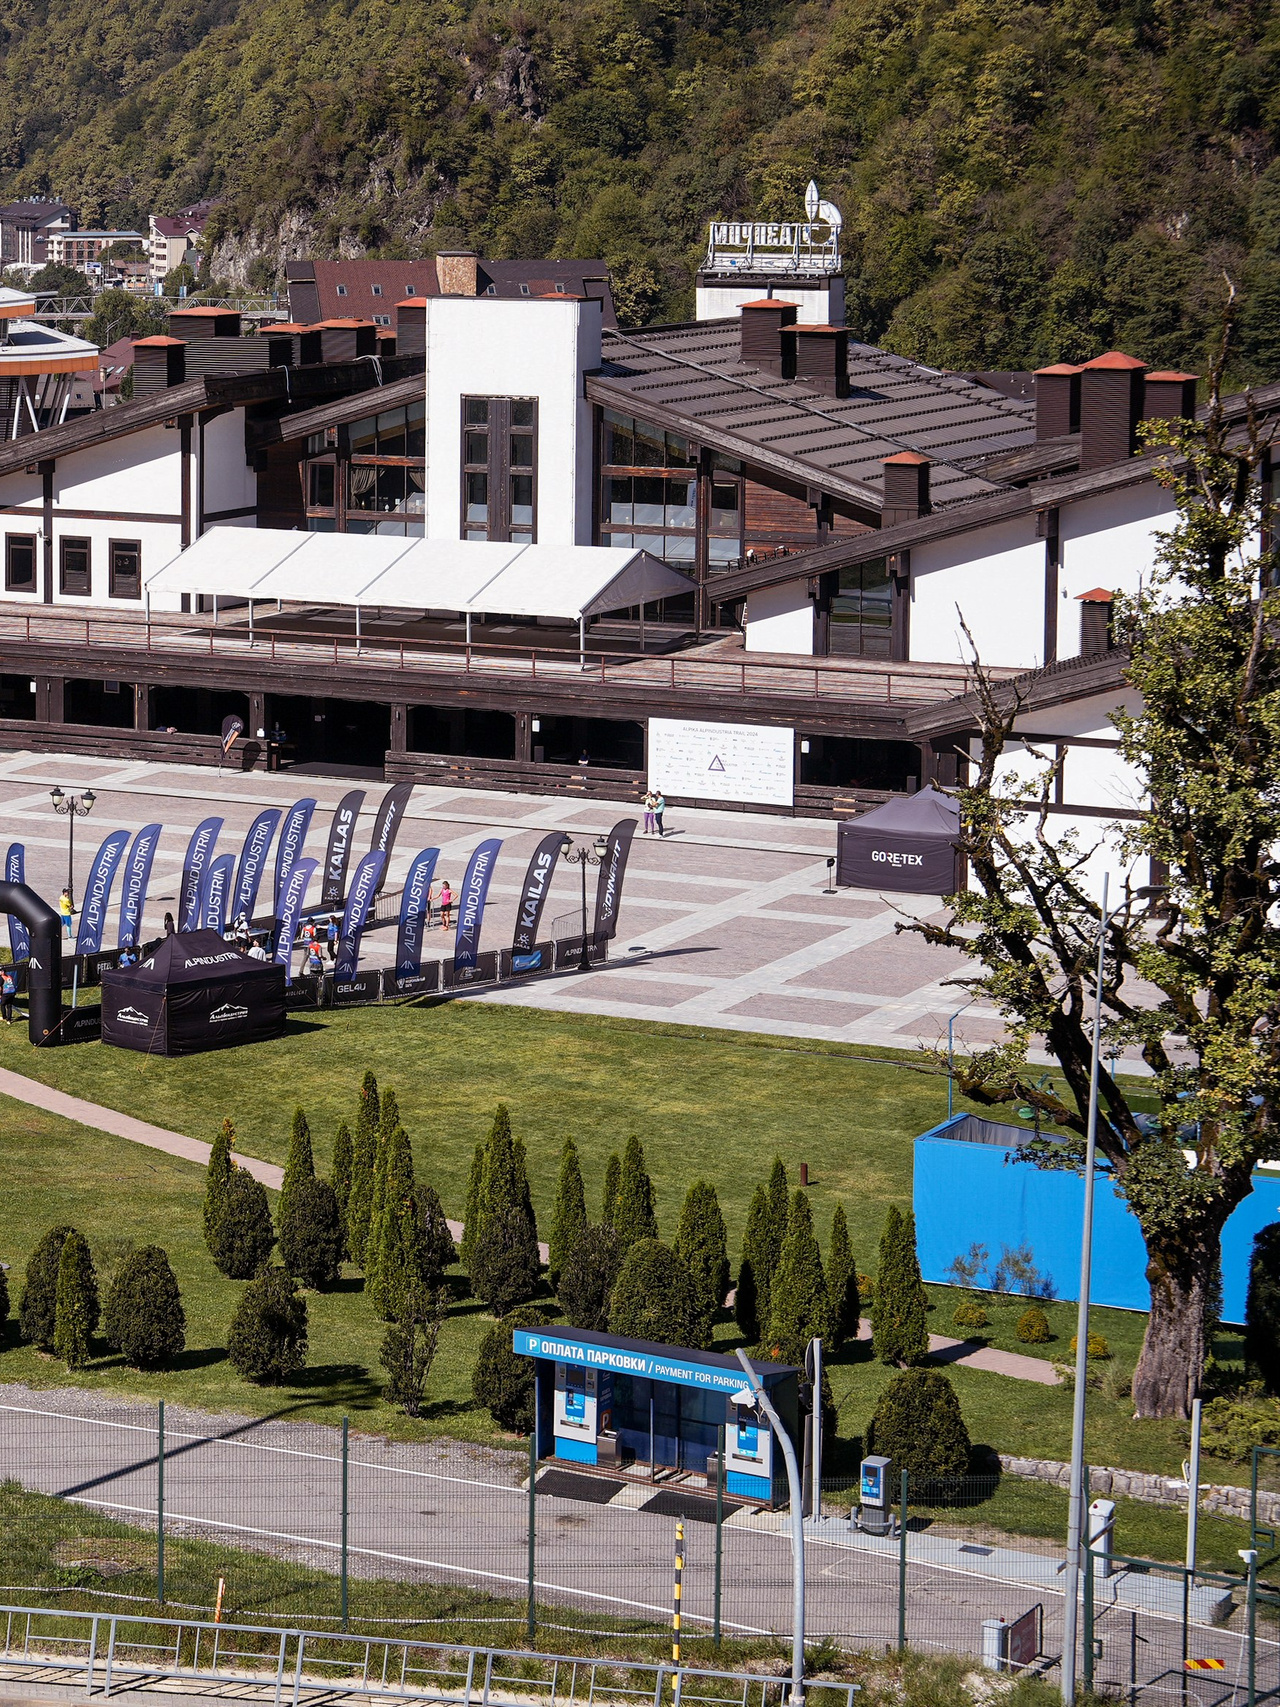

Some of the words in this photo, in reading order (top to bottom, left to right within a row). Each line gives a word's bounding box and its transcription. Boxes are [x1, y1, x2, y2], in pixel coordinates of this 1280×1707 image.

[239, 820, 271, 906] ALPINDUSTRIA
[329, 808, 353, 881] KAILAS
[378, 801, 395, 852] YNAFIT
[871, 850, 923, 866] GORE-TEX
[86, 841, 120, 931] ALPINDUSTRIA
[126, 836, 152, 926] ALPINDUSTRIA
[185, 828, 213, 916] ALPINDUSTRIA
[346, 862, 376, 957] ALPINDUSTRIA
[404, 860, 430, 953] ALPINDUSTRIA
[463, 850, 491, 944] ALPINDUSTRIA
[521, 851, 552, 928] KAILAS
[277, 868, 308, 963] ALPINDUSTRIA
[184, 951, 243, 969] ALPINDUSTRIA
[337, 982, 366, 993] GEL4U
[541, 1341, 585, 1361] ОПЛАТА
[586, 1349, 646, 1372] ПАРКОВКИ
[655, 1364, 694, 1380] PAYMENT
[694, 1372, 712, 1384] FOR
[713, 1375, 749, 1390] PARKING
